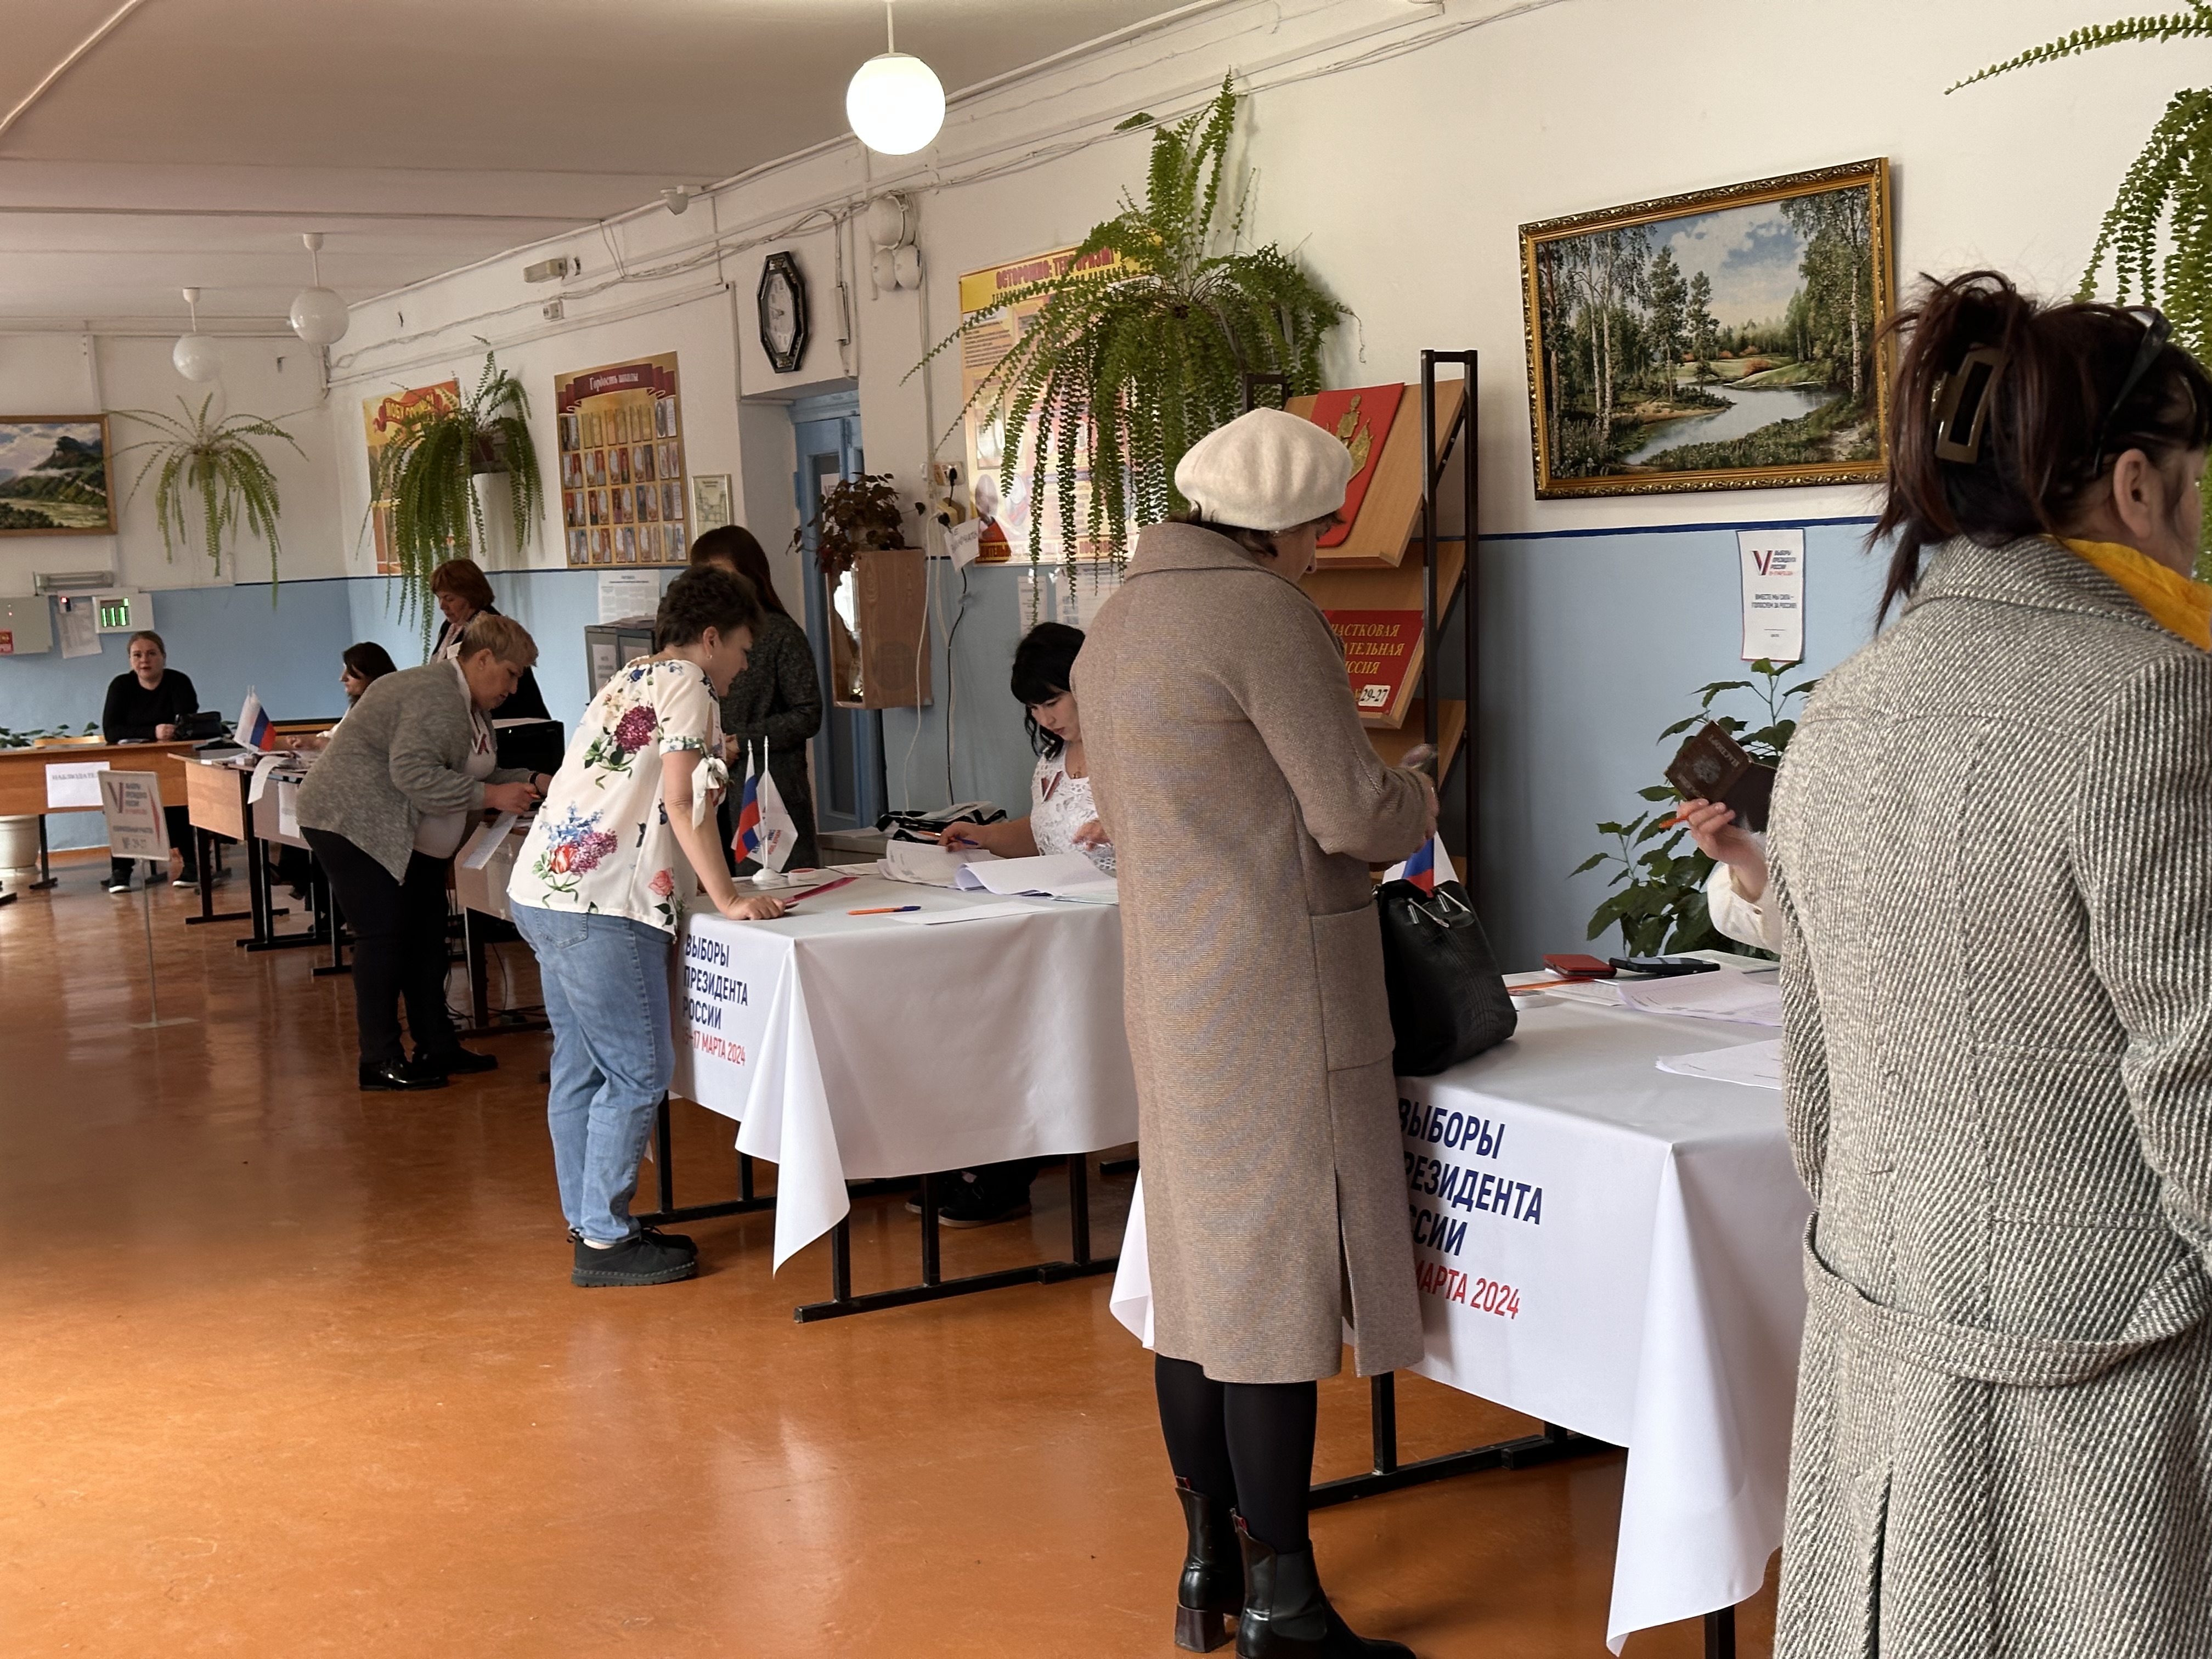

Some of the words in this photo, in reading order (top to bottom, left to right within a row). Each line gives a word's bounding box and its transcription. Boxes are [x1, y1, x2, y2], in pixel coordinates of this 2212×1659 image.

[1331, 624, 1401, 636] ЧАСТКОВАЯ
[1360, 689, 1388, 702] 29-27
[686, 933, 730, 967] ВЫБОРЫ
[684, 965, 748, 1006] ПРЕЗИДЕНТА
[682, 996, 721, 1030] РОССИИ
[702, 1032, 726, 1060] МАРТА
[727, 1042, 746, 1066] 2024
[1398, 1097, 1505, 1159] ВЫБОРЫ
[1403, 1151, 1543, 1225] РЕЗИДЕНТА
[1470, 1278, 1520, 1320] 2024
